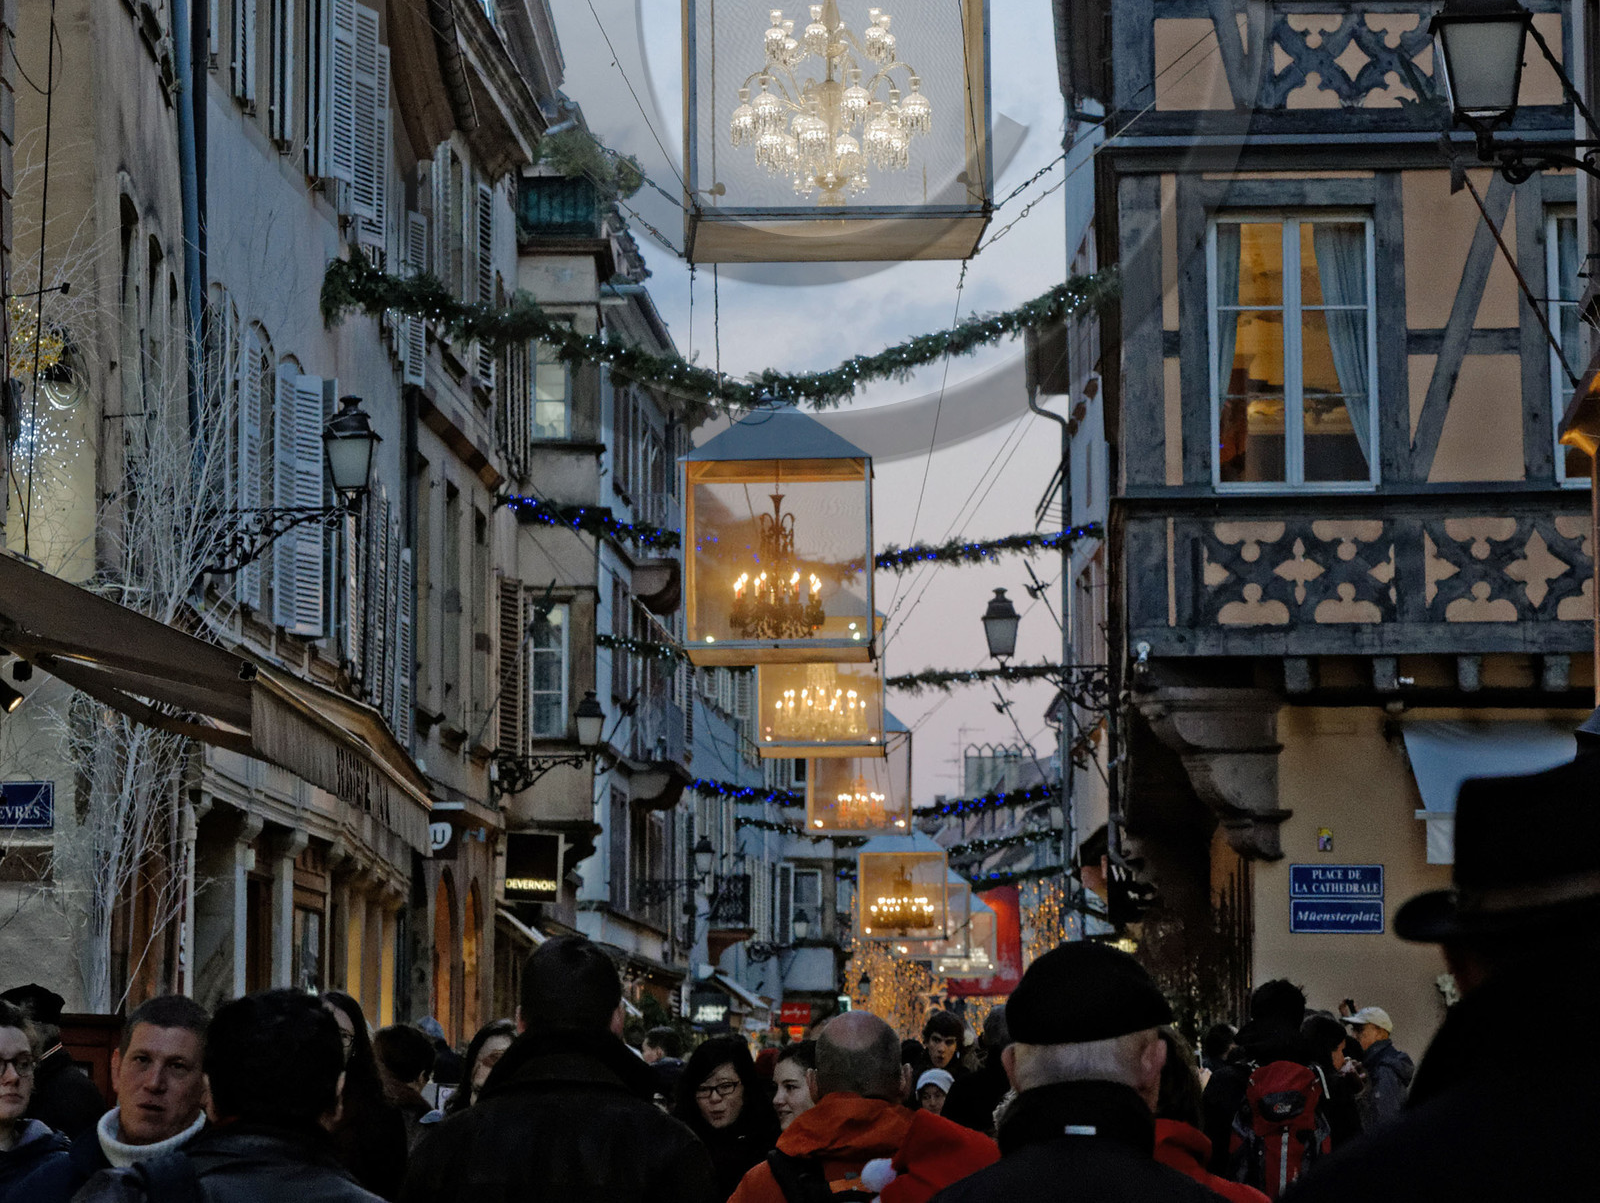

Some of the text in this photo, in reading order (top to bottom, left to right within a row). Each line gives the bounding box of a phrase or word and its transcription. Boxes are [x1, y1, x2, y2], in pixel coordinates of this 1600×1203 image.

[1312, 869, 1362, 879] PLACE DE
[505, 878, 557, 891] DEVERNOIS
[1294, 882, 1380, 893] LA CATHEDRALE
